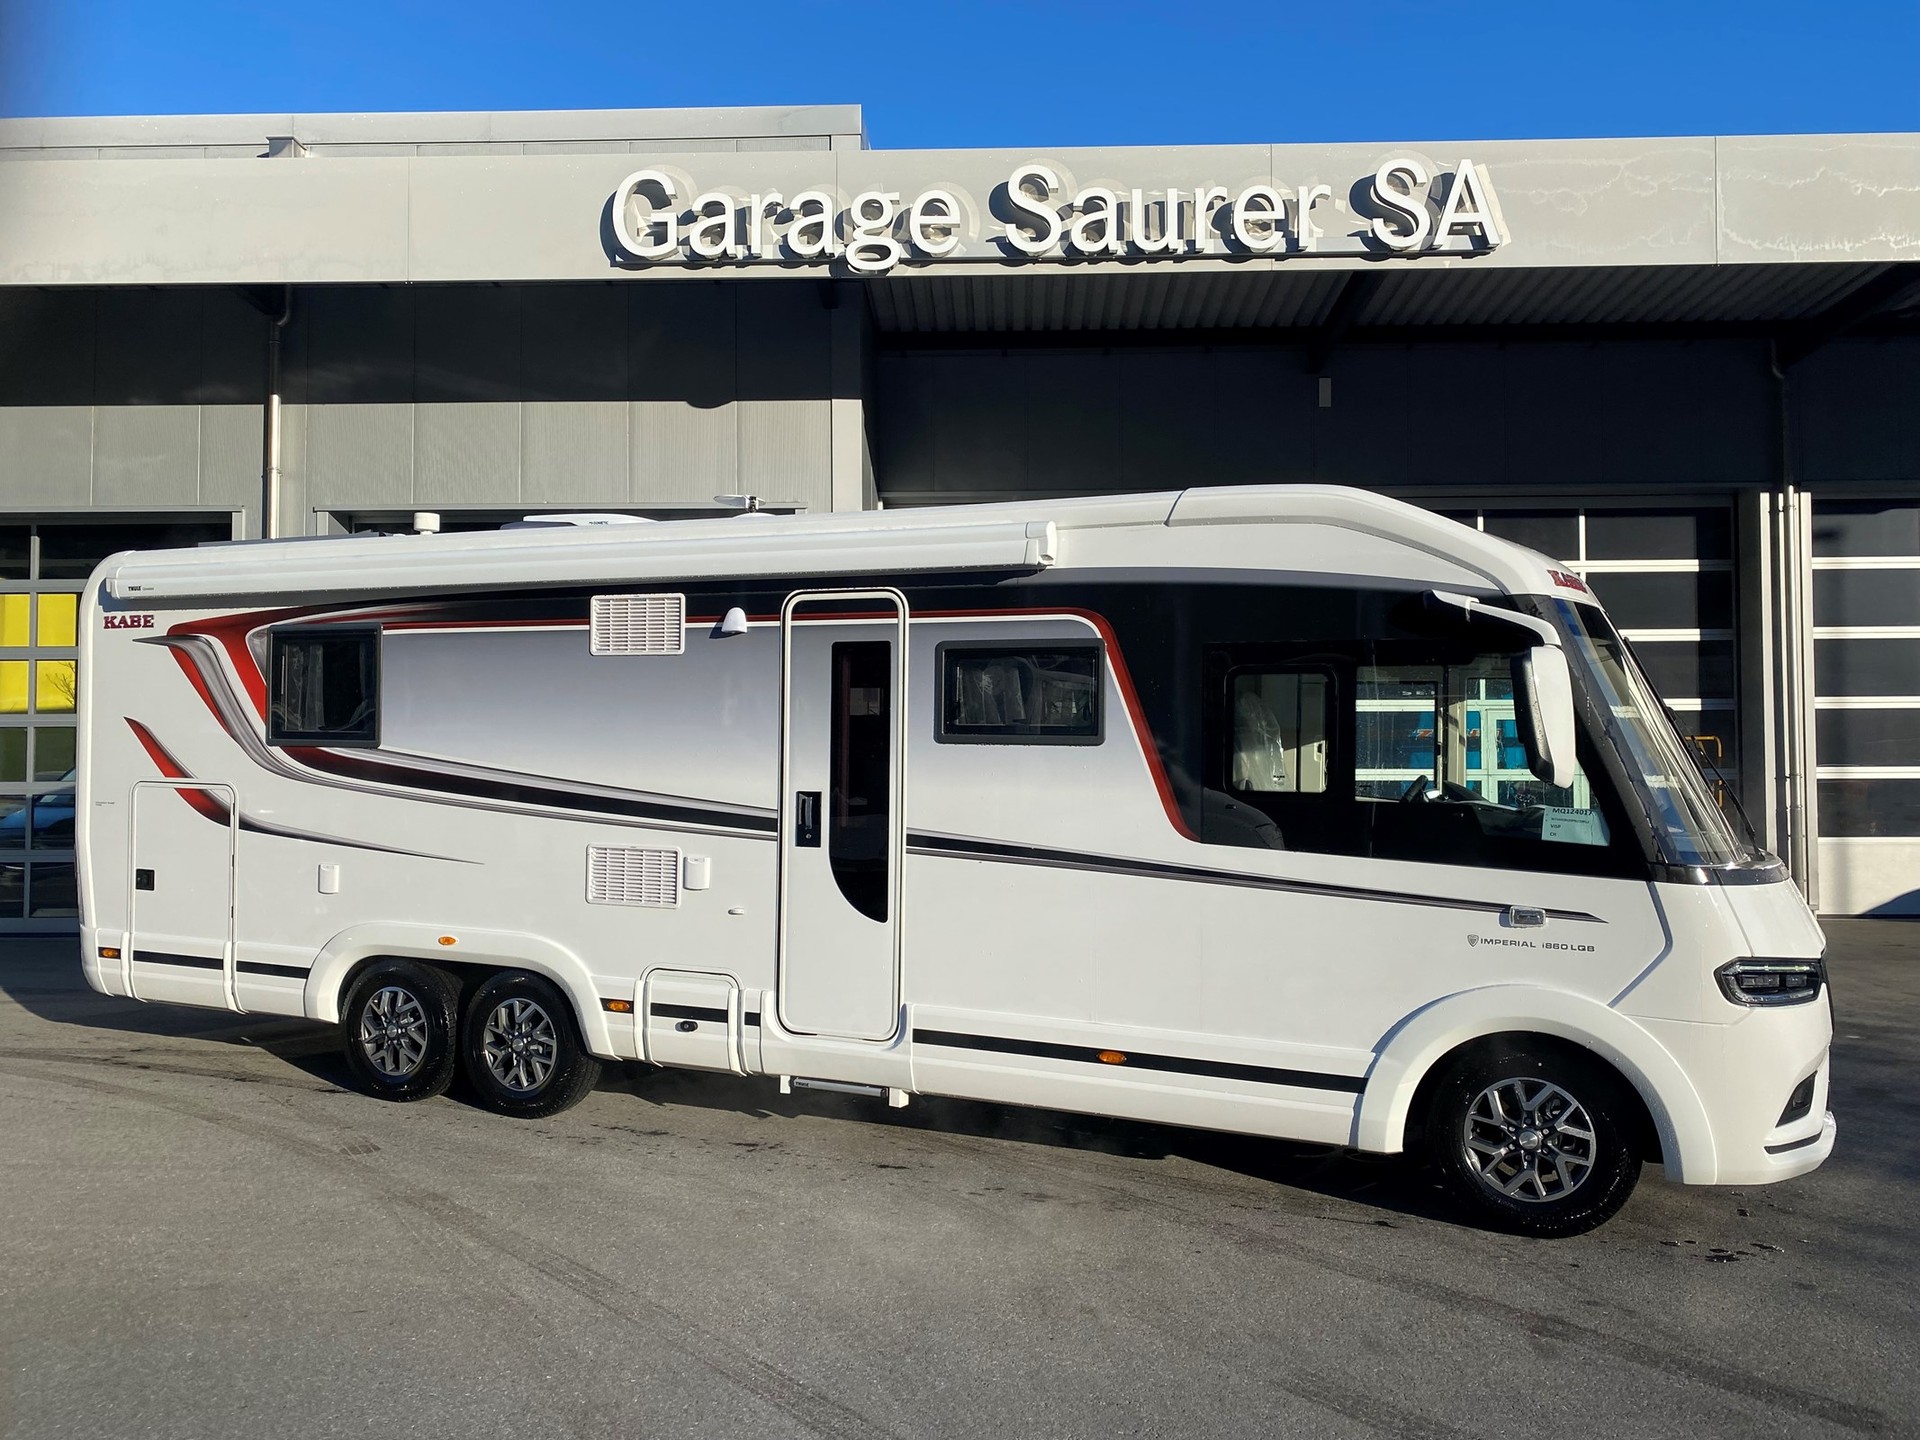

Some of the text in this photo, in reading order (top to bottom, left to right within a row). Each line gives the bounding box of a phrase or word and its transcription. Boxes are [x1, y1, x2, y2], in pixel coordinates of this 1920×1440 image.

[612, 158, 1501, 272] Garage Saurer SA
[103, 614, 155, 629] KABE
[1552, 808, 1593, 816] MQ124017
[1480, 938, 1595, 952] IMPERIAL i860 LQB
